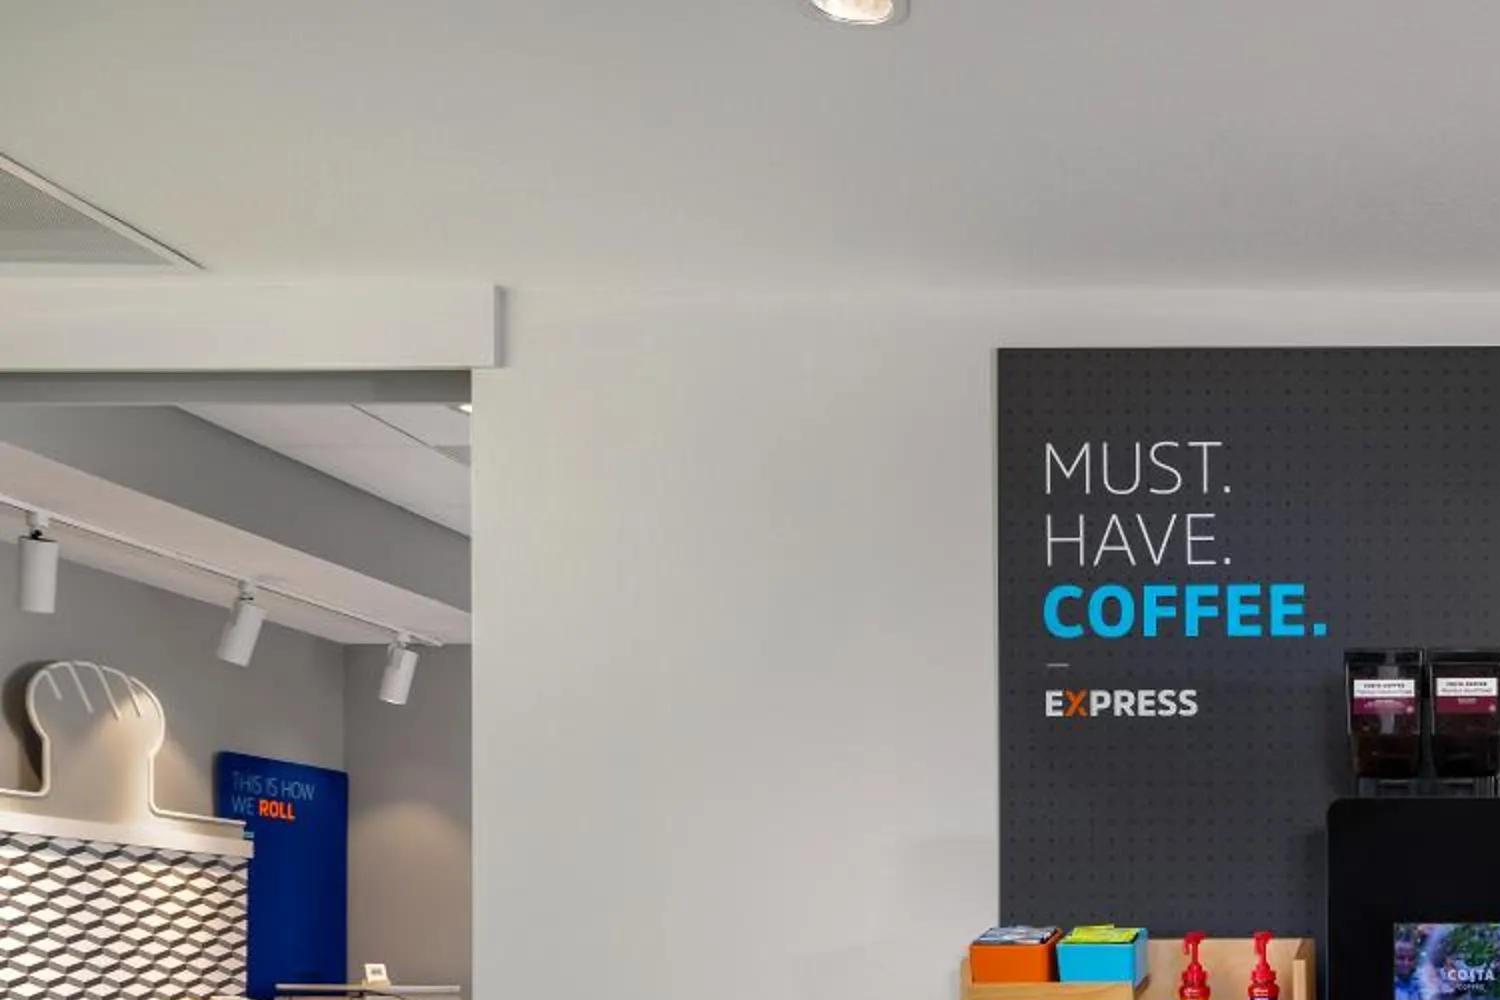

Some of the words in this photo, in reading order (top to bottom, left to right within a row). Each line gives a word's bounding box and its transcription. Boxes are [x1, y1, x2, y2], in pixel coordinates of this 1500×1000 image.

[1045, 441, 1232, 495] MUST.
[1045, 513, 1232, 566] HAVE.
[1042, 584, 1327, 639] COFFEE.
[1045, 689, 1199, 717] EXPRESS
[232, 770, 262, 796] THIS
[281, 780, 315, 801] HOW
[231, 793, 256, 816] WE
[259, 799, 296, 821] ROLL
[1448, 968, 1495, 982] COSTA
